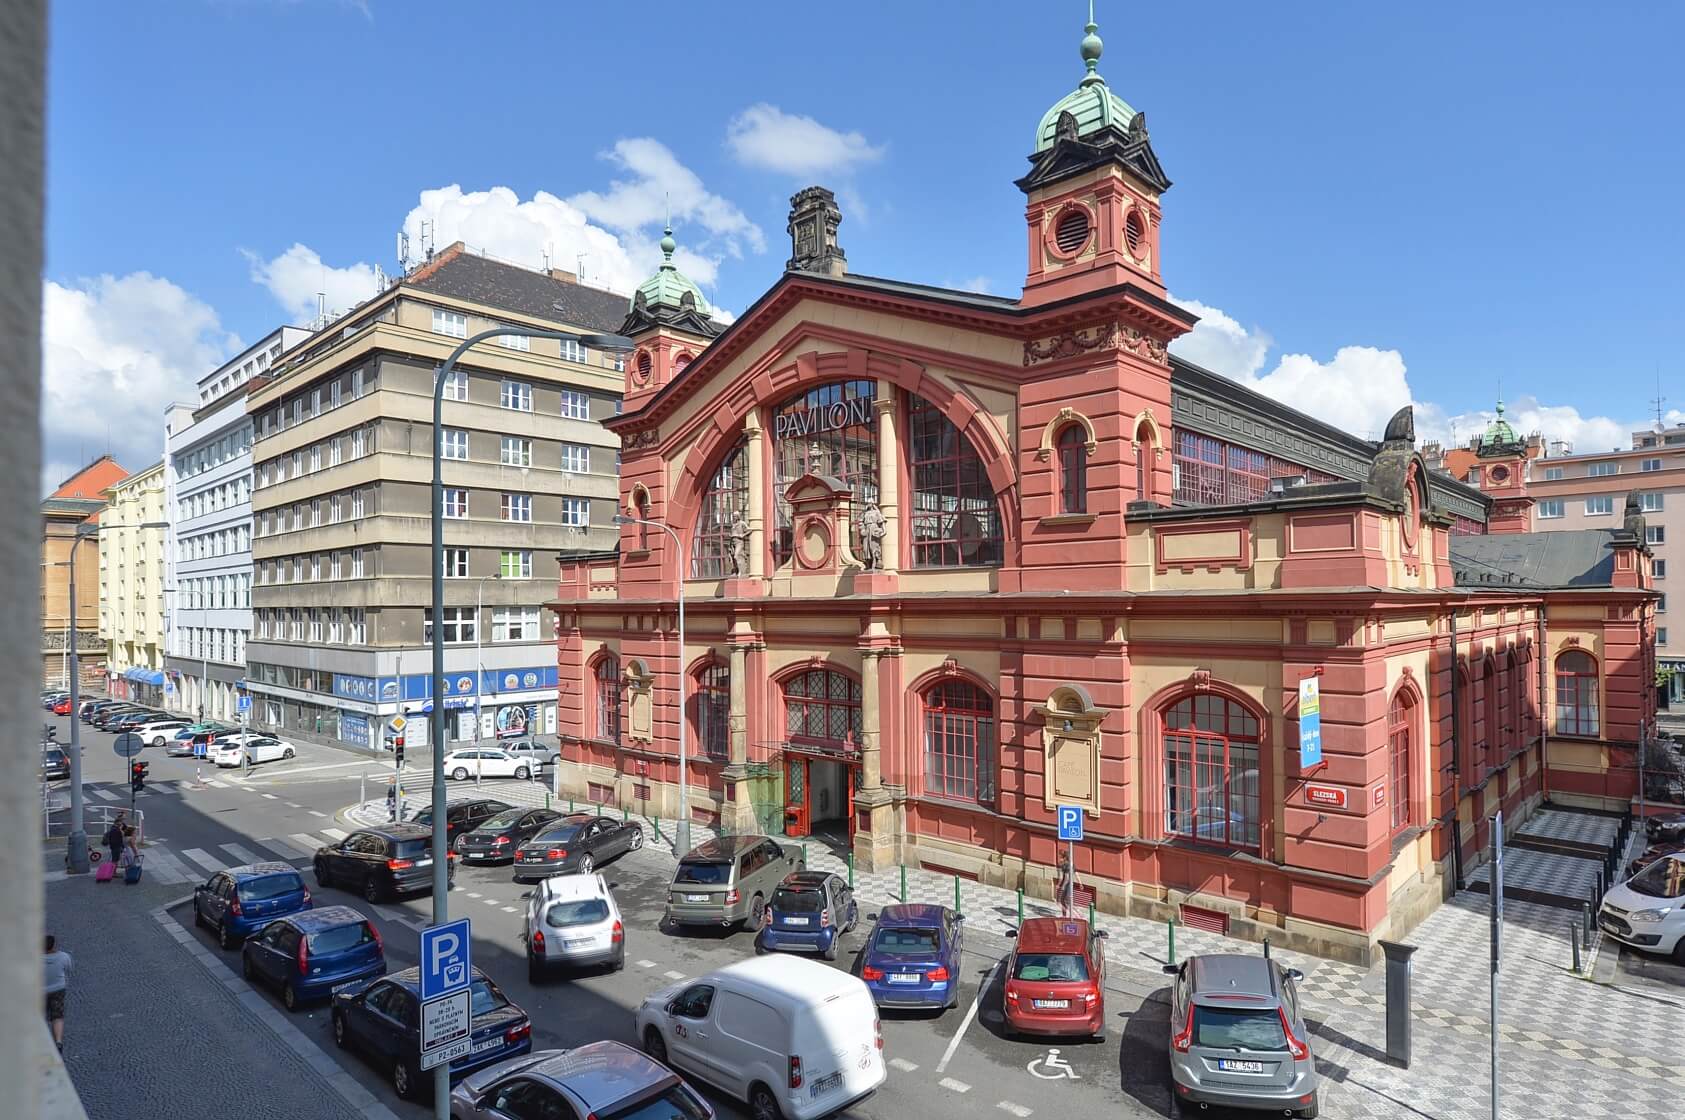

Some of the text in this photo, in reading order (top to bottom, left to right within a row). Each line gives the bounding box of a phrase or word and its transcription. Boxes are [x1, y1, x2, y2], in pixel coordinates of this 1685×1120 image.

[1063, 809, 1077, 829] P
[432, 932, 460, 976] P
[438, 1044, 465, 1060] P2-0563
